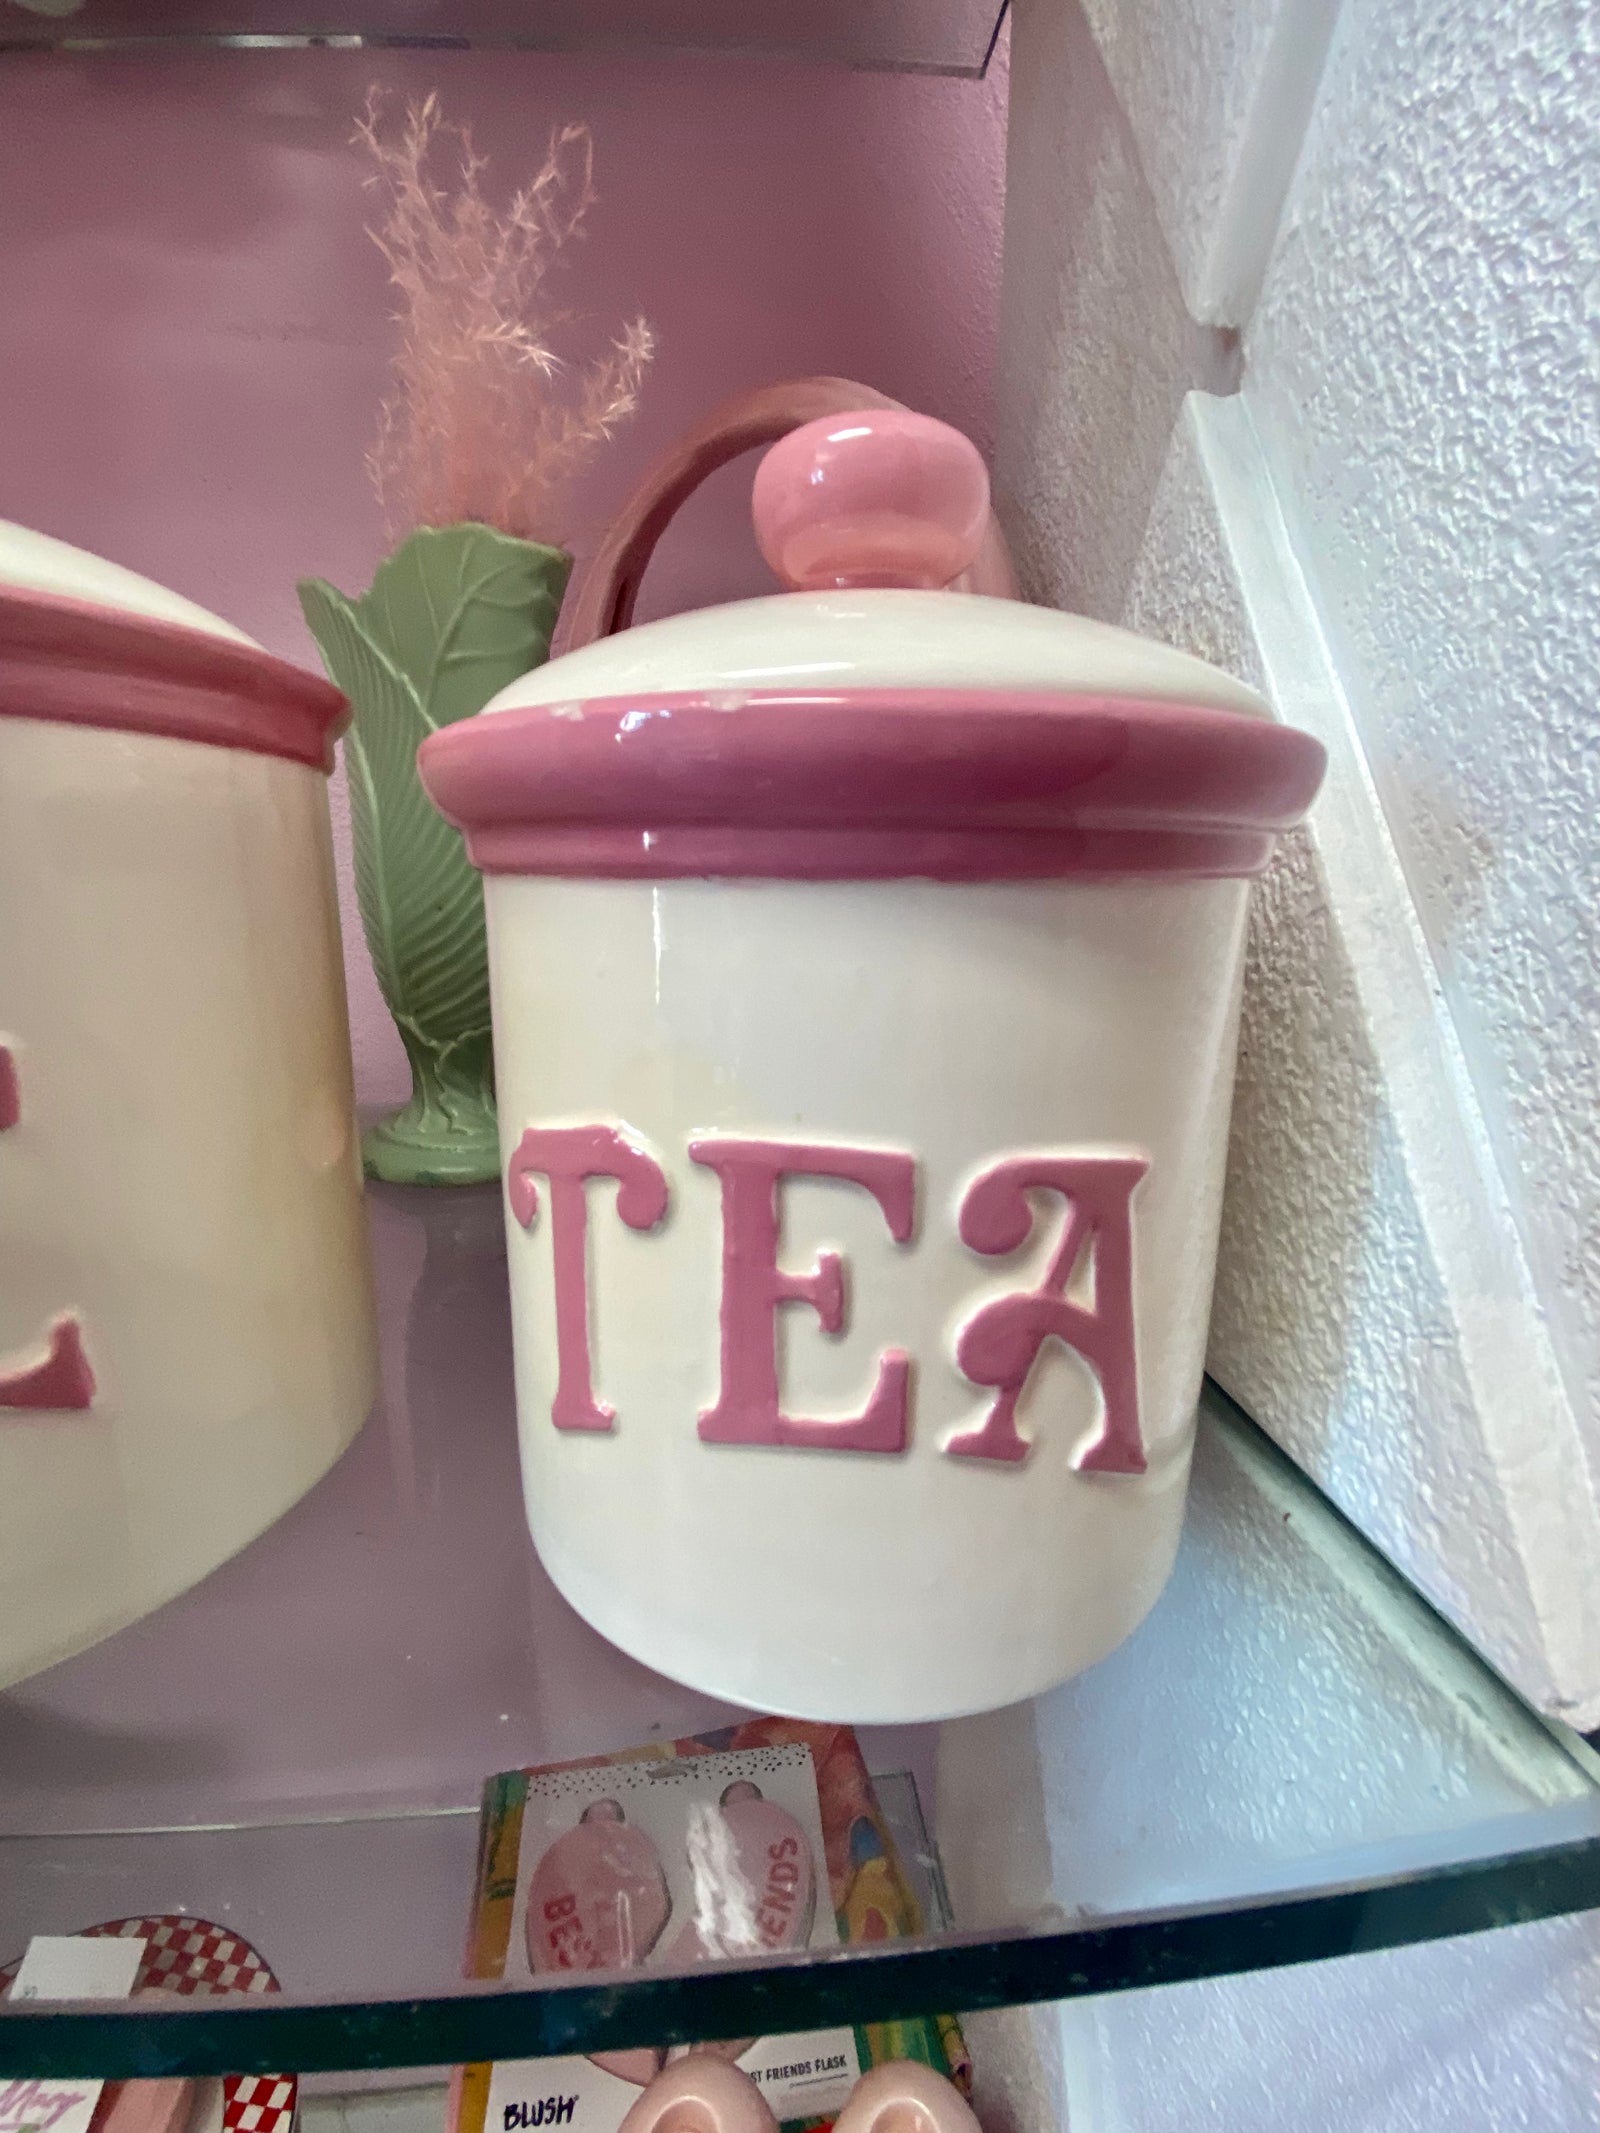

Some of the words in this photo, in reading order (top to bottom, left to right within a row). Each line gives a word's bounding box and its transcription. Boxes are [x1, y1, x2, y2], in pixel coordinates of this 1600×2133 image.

[508, 1124, 1149, 1474] TEA
[747, 2069, 763, 2083] ST
[766, 2060, 812, 2081] FRIENDS
[814, 2054, 847, 2073] FLASK
[504, 2095, 576, 2131] BLUSH
